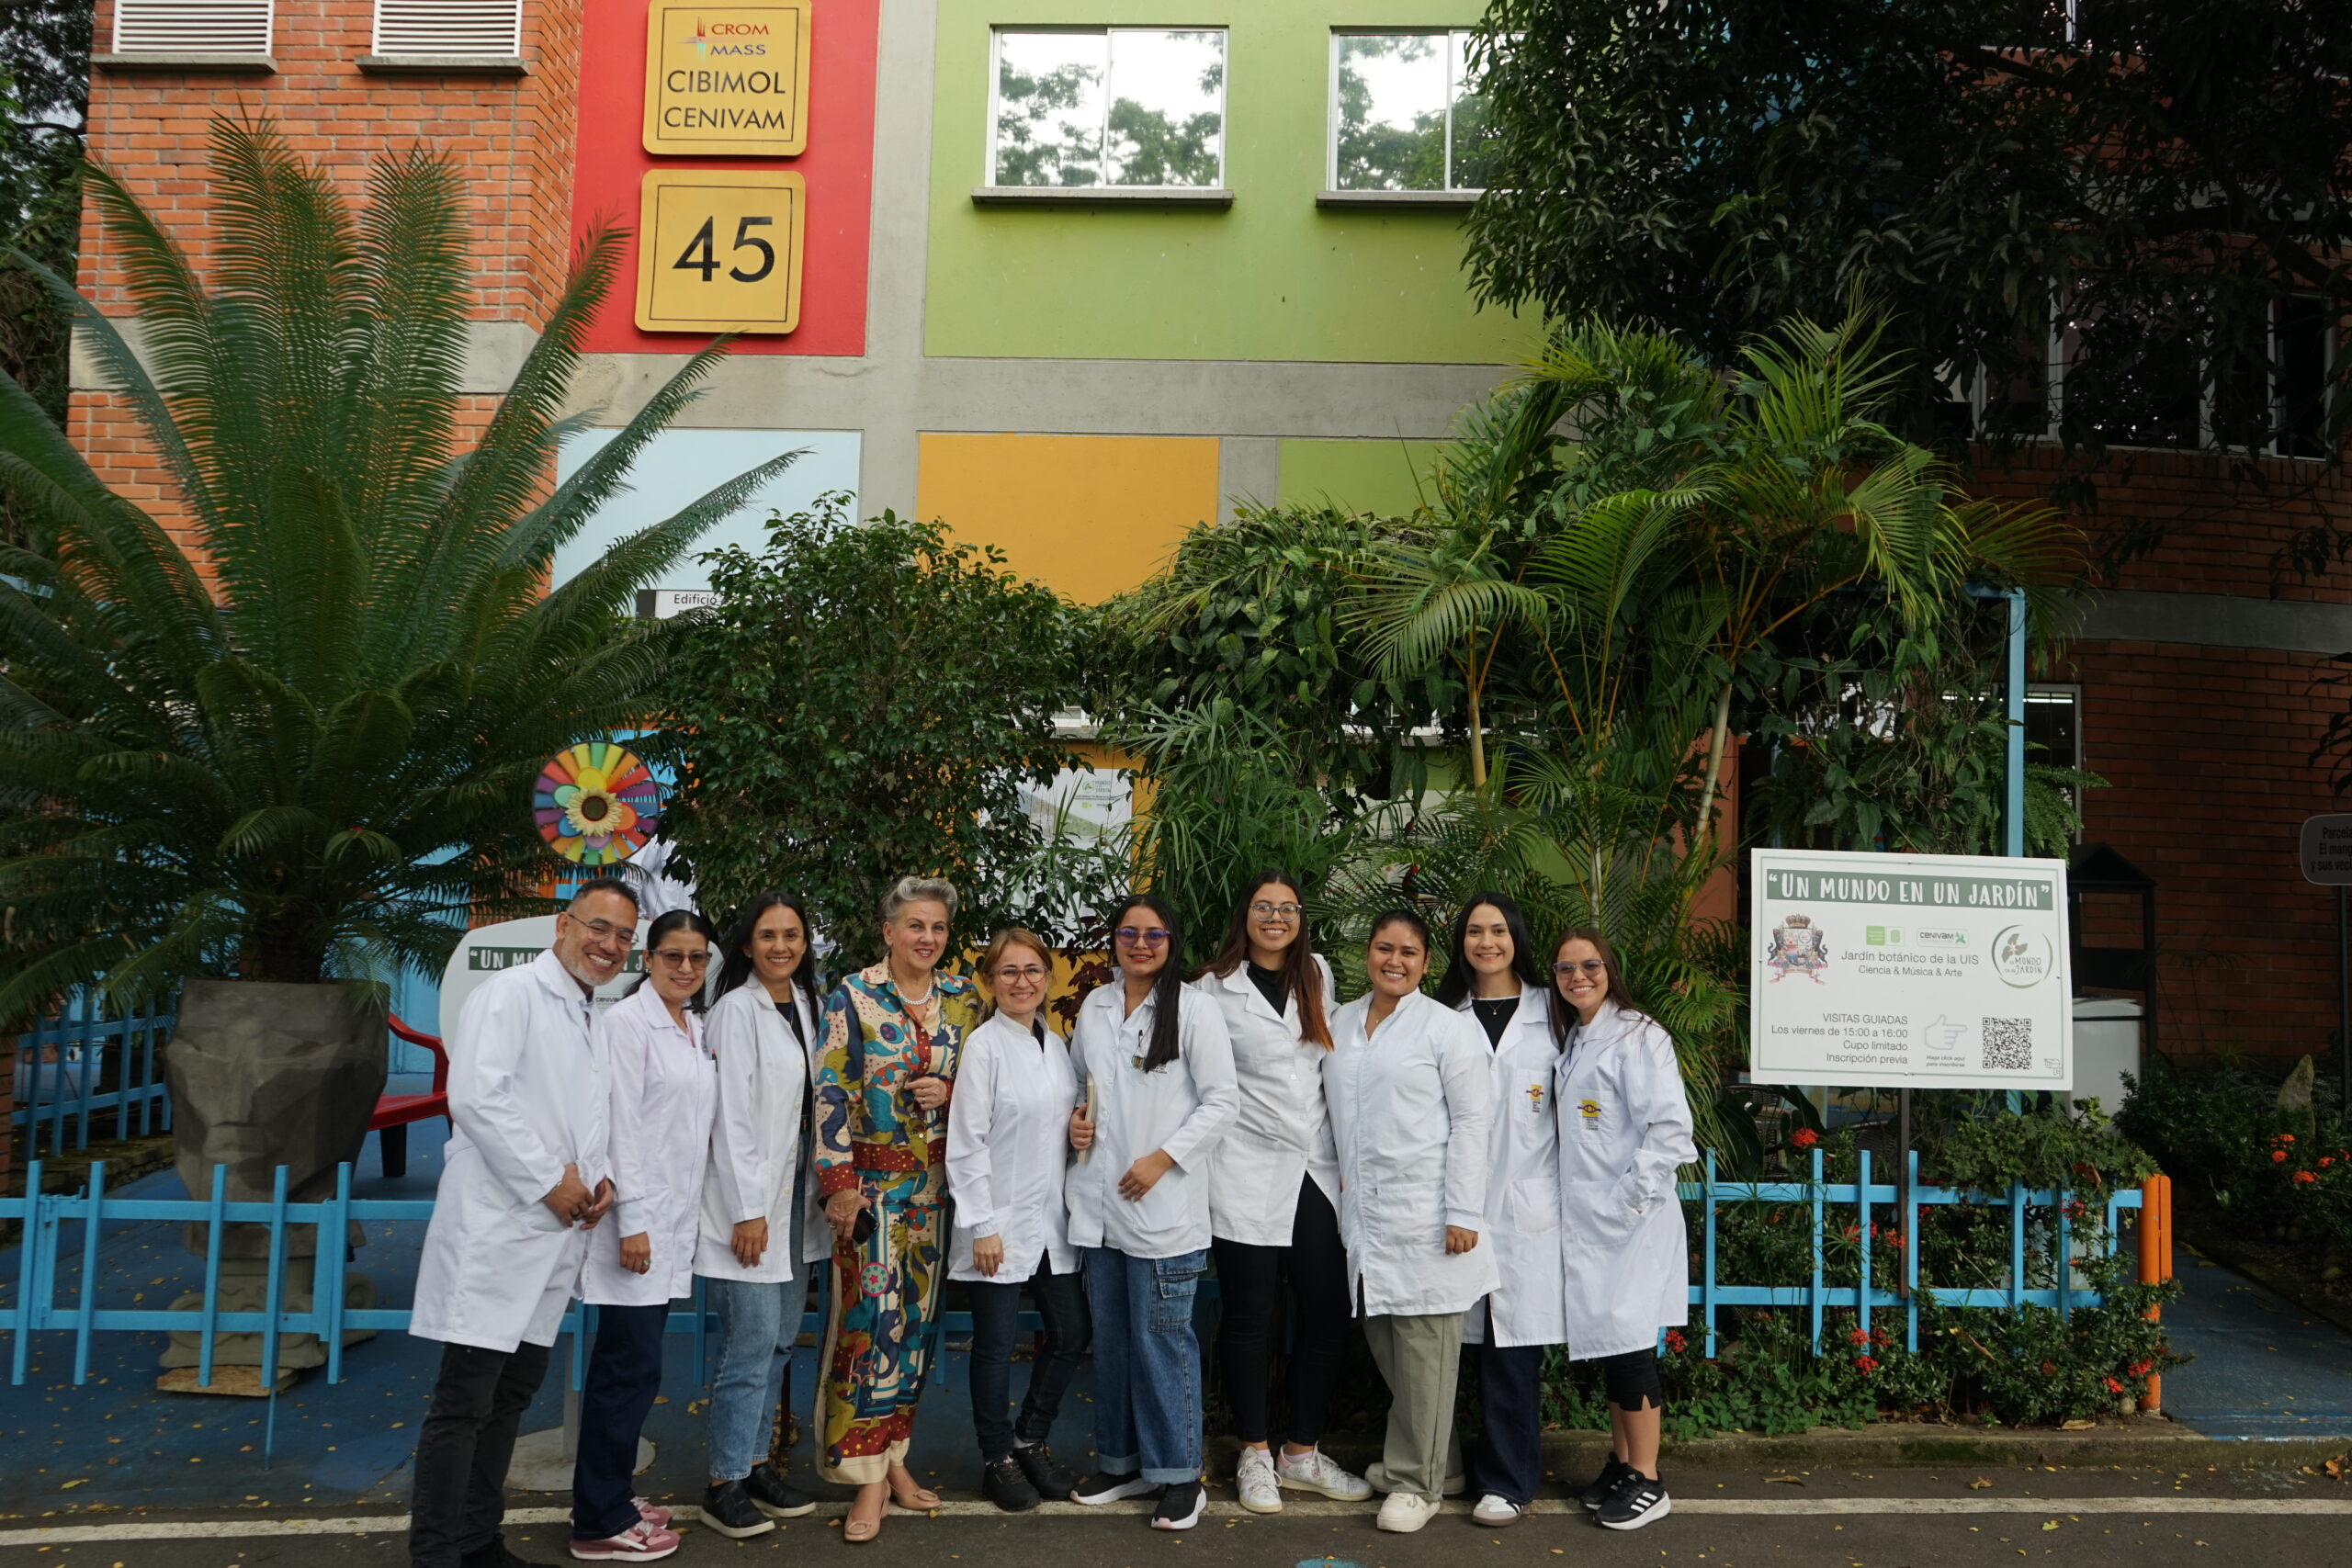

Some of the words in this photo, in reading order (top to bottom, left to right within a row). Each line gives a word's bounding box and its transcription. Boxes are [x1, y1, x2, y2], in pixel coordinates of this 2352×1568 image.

[711, 24, 770, 35] CROM
[710, 45, 766, 56] MASS
[667, 70, 786, 95] CIBIMOL
[664, 107, 786, 130] CENIVAM
[672, 215, 775, 283] 45
[674, 593, 717, 604] Edificio
[1820, 877, 1890, 901] MUNDO
[1899, 881, 1924, 903] EN
[1934, 882, 1960, 904] UN
[1841, 951, 1875, 962] Jardín
[1879, 952, 1927, 964] botánico
[1929, 953, 1944, 964] de
[1948, 954, 1956, 964] la
[1960, 955, 1979, 964] UIS
[2015, 956, 2041, 965] MUNDO
[1859, 965, 1891, 975] Ciencia
[1894, 967, 1900, 976] &
[1902, 967, 1933, 976] Música
[1944, 969, 1962, 977] Arte
[1823, 1013, 1860, 1023] VISITAS
[1863, 1014, 1908, 1025] GUIADAS
[1771, 1025, 1789, 1034] Los
[1792, 1026, 1826, 1035] viernes
[1827, 1027, 1840, 1036] de
[1844, 1028, 1870, 1037] 15:00
[1883, 1029, 1908, 1038] 16:00
[1843, 1040, 1869, 1051] Cupo
[1871, 1041, 1908, 1051] limitado
[1826, 1054, 1877, 1064] Inscripción
[1880, 1055, 1908, 1065] previa
